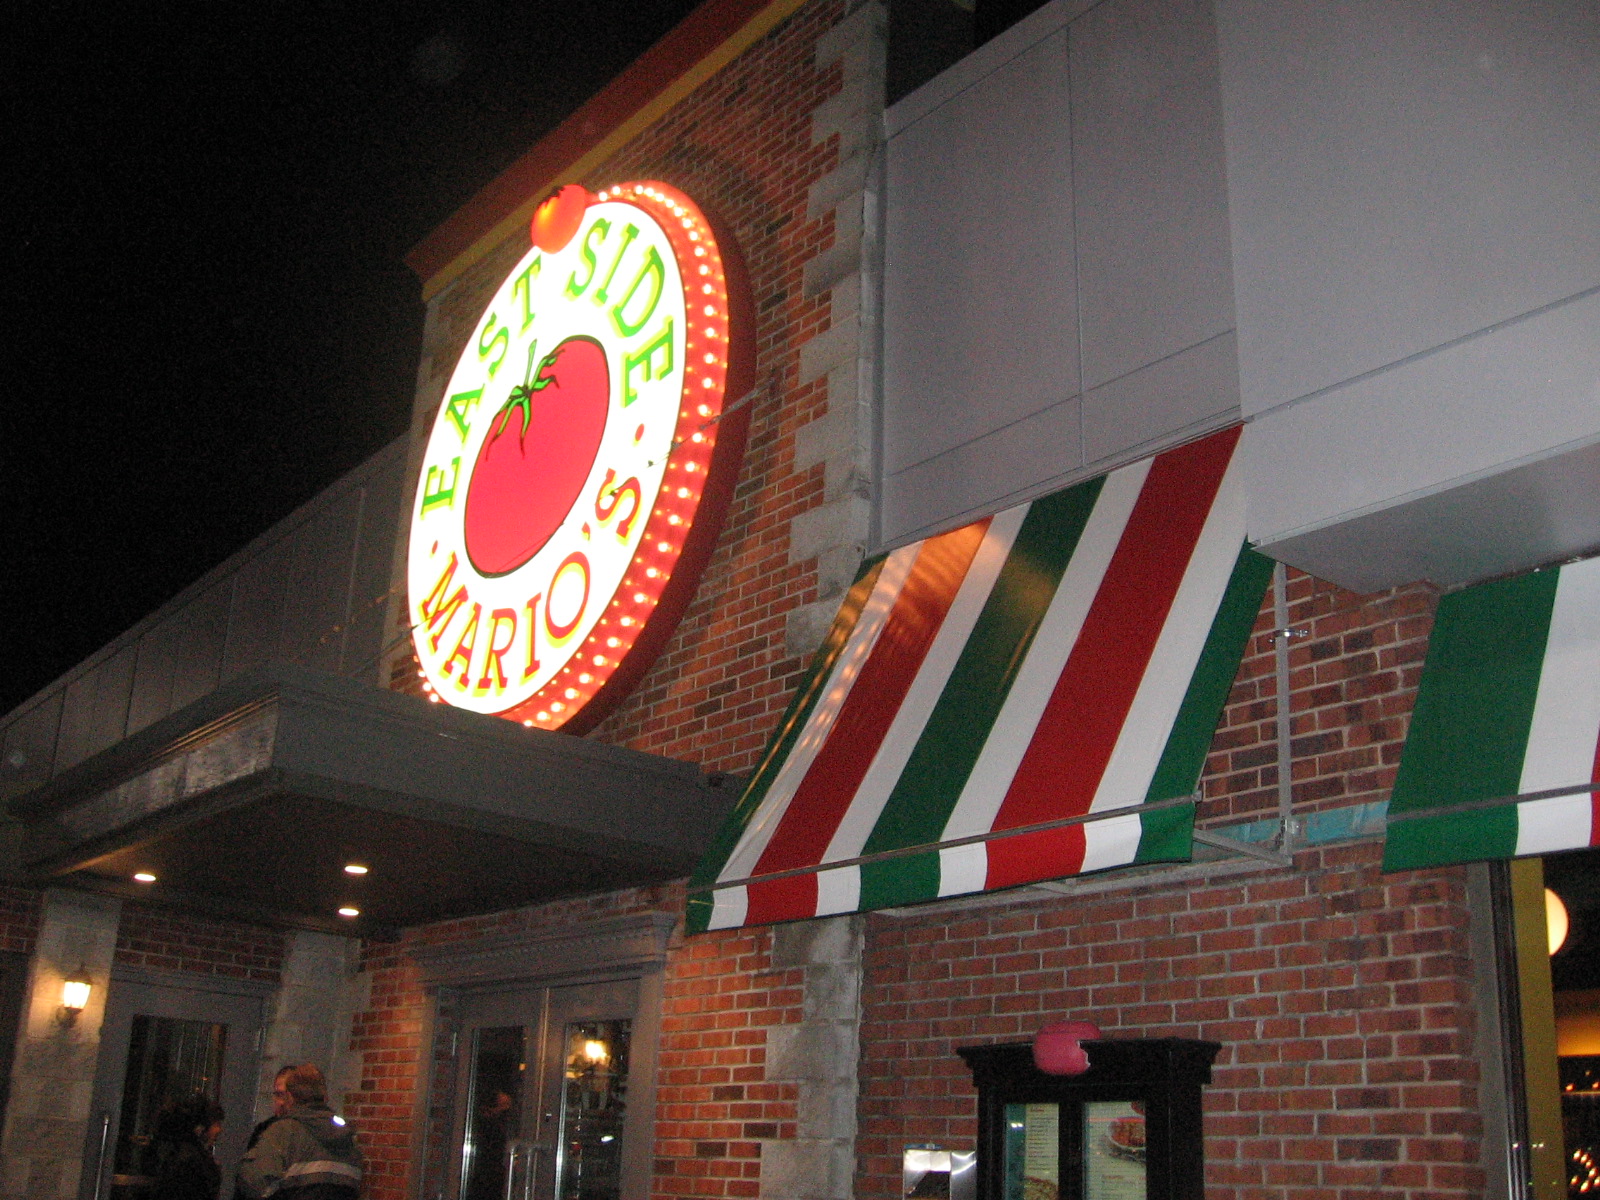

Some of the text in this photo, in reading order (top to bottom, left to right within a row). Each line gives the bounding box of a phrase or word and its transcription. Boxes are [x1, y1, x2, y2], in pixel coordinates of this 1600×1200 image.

[420, 217, 674, 518] EAST SIDE
[418, 468, 642, 695] MARIO'S
